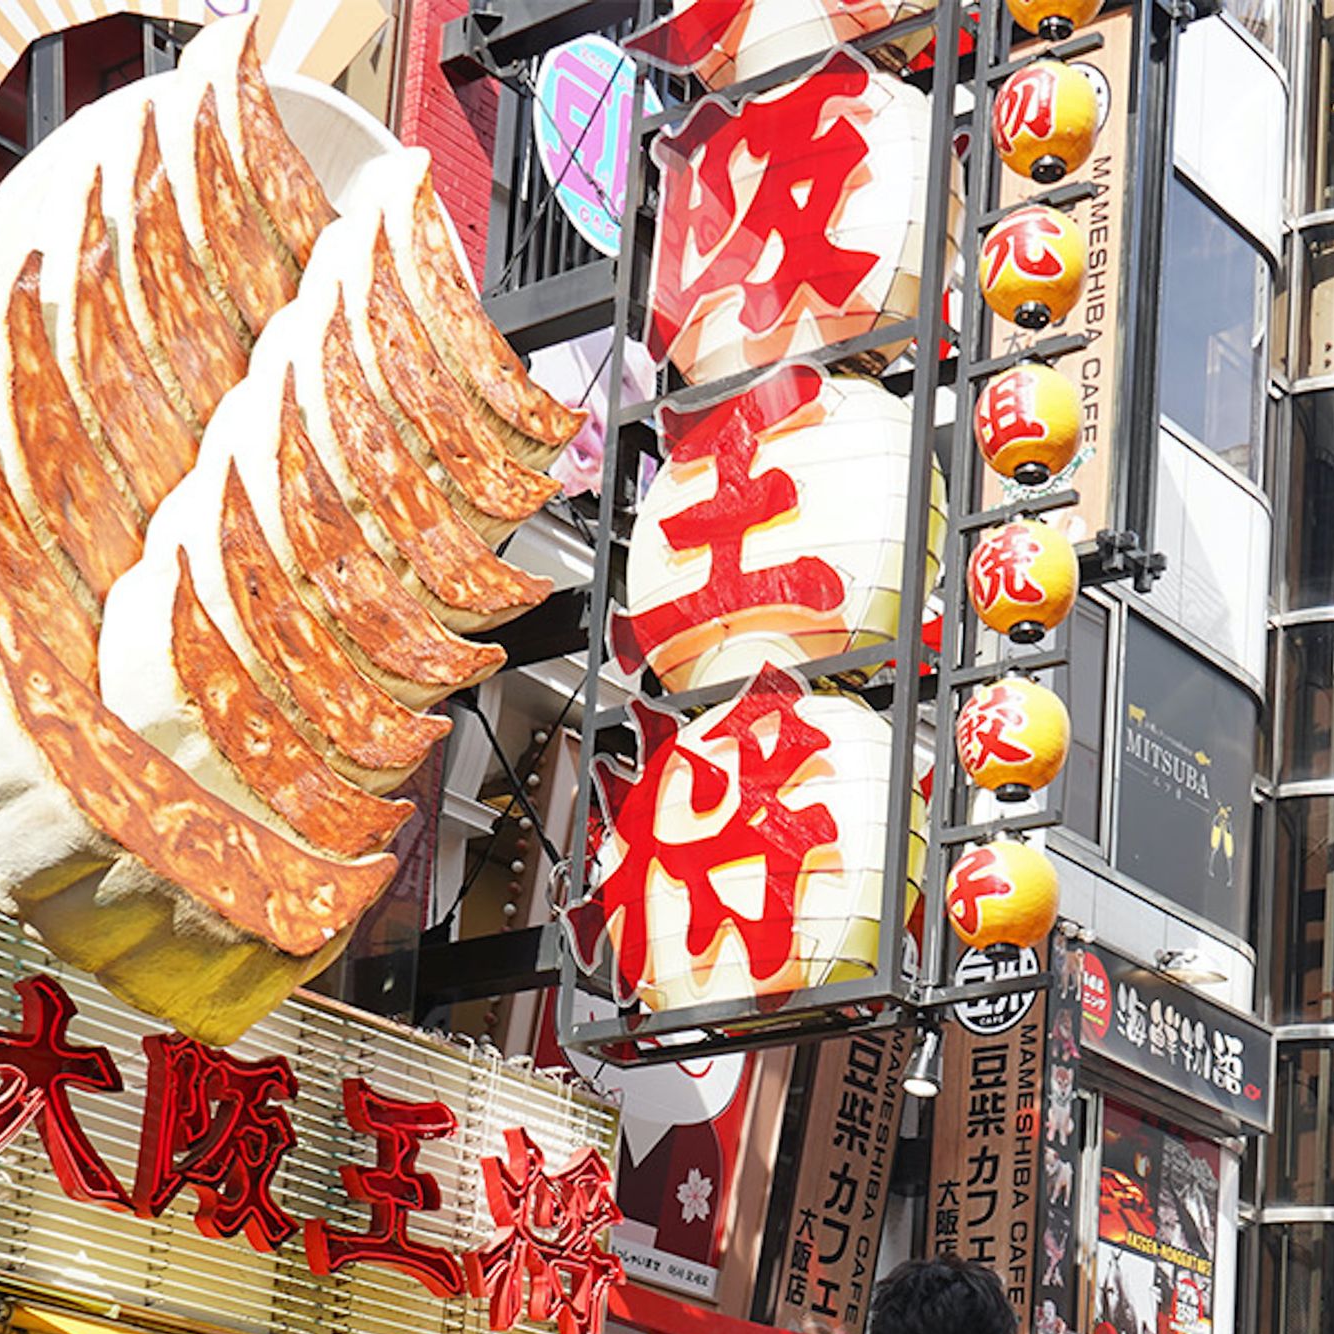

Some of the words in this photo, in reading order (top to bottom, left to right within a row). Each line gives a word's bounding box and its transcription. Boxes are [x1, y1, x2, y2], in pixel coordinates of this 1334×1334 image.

[1080, 357, 1101, 444] CAFE
[1125, 726, 1210, 800] MITSUBA
[1011, 1023, 1037, 1209] MAMESHIBA
[784, 1207, 818, 1306] 大阪店
[843, 1236, 869, 1327] CAFE
[1007, 1221, 1029, 1305] CAFE
